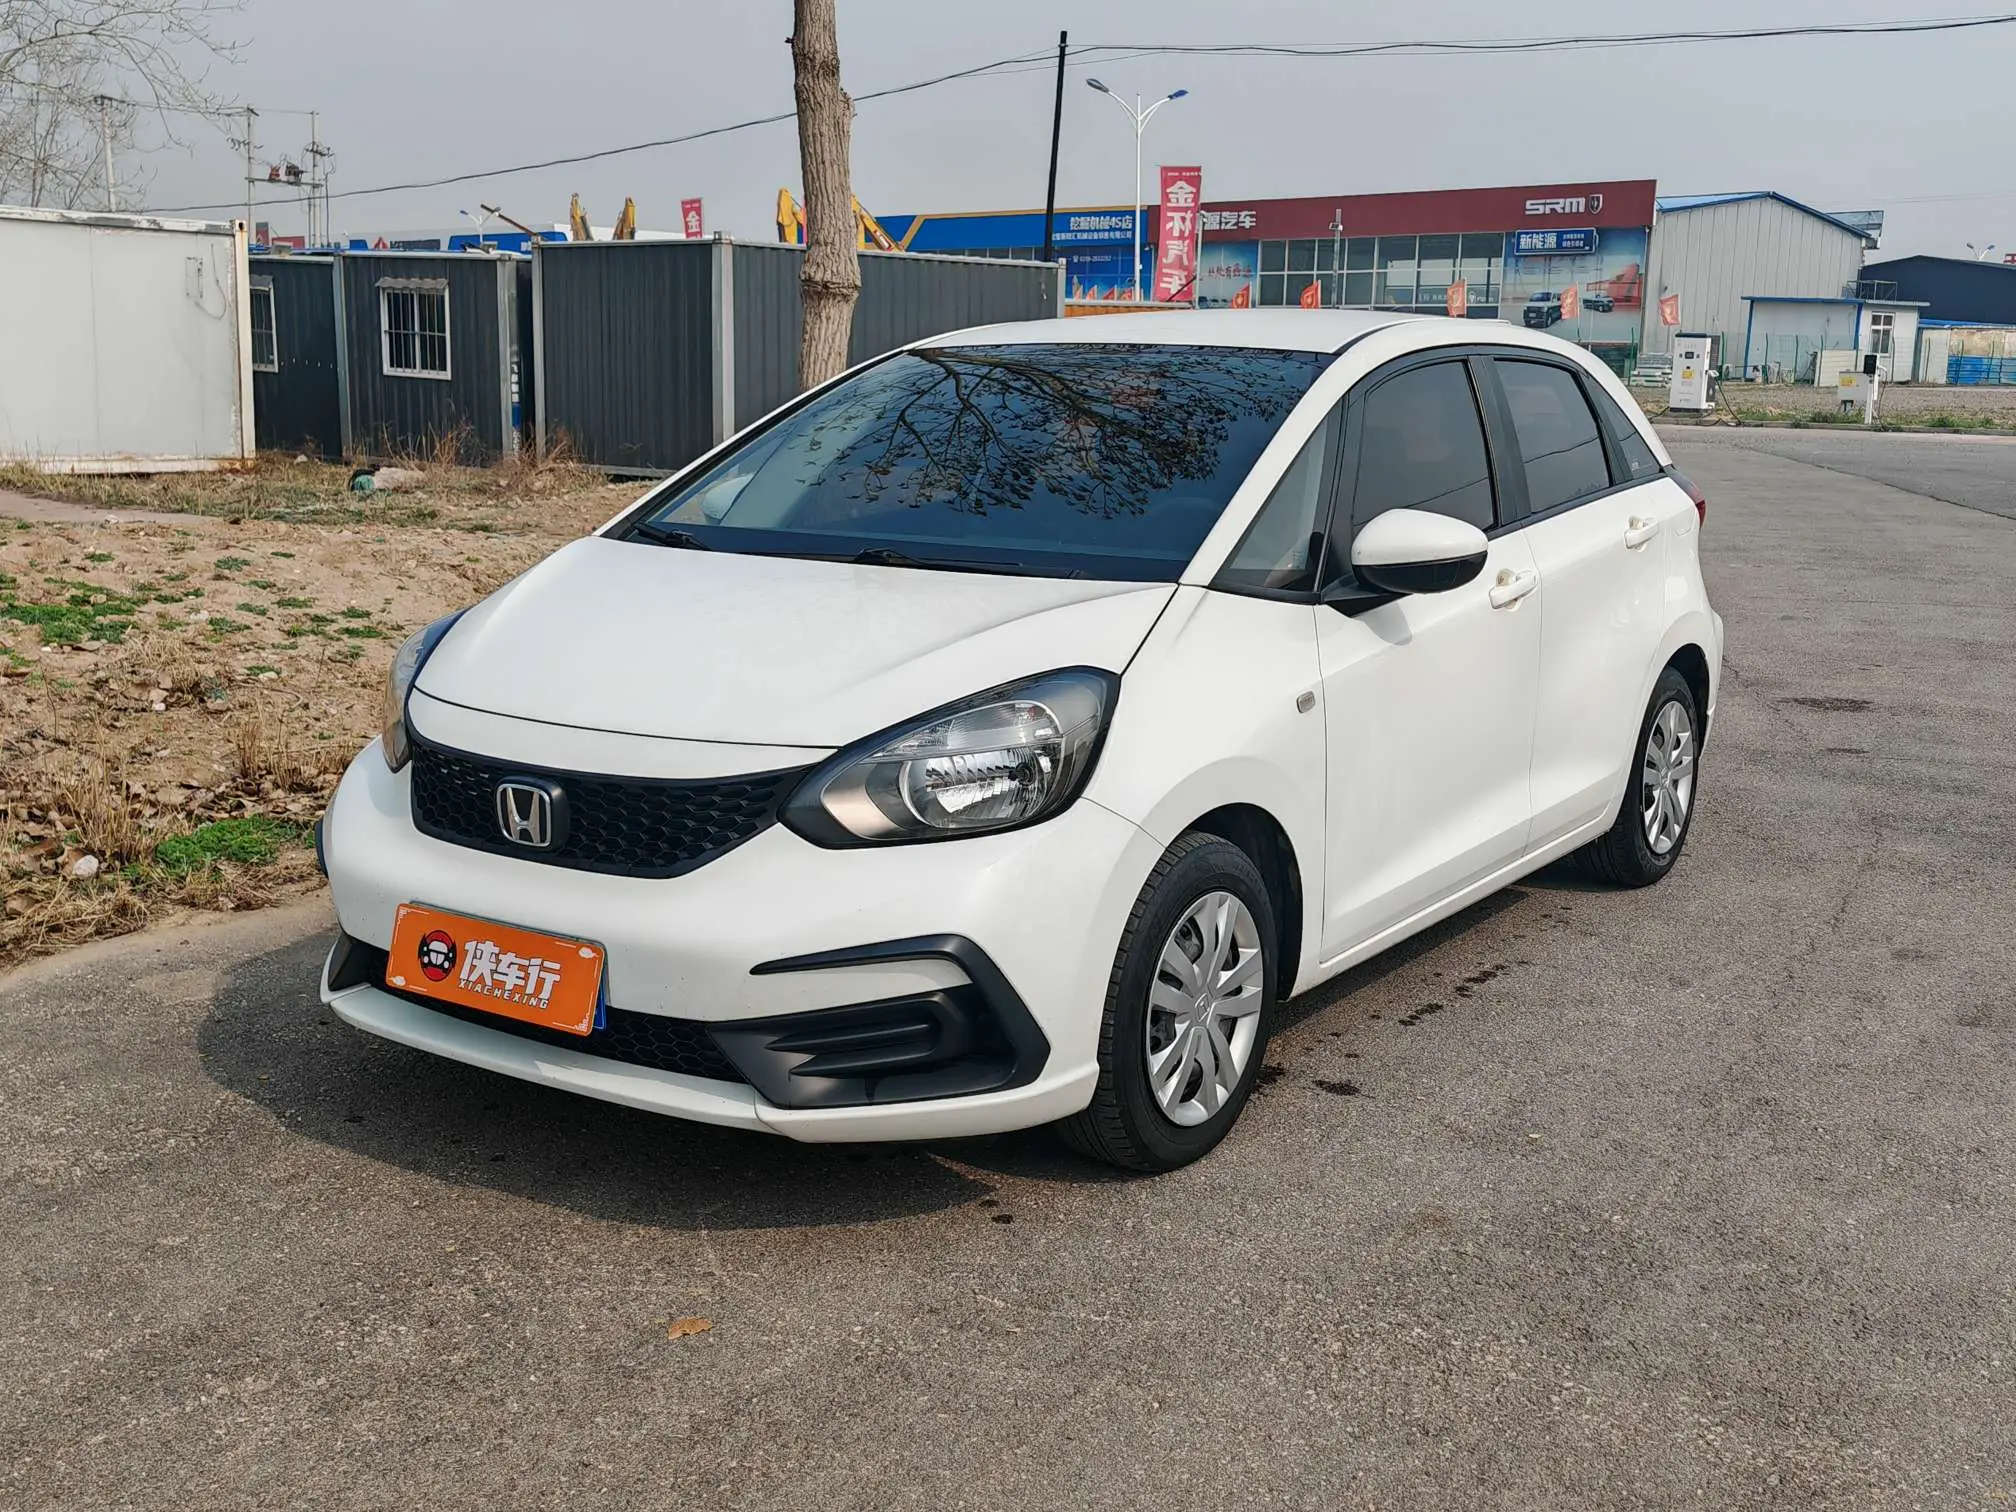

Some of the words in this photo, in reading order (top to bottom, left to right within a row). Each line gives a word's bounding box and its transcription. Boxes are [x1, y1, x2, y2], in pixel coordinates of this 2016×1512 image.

[1525, 197, 1586, 215] SRM
[1196, 209, 1257, 232] 源汽车
[1519, 232, 1558, 250] 新能源
[459, 939, 561, 1000] 侠车行
[458, 978, 550, 1010] XIACHEXING
